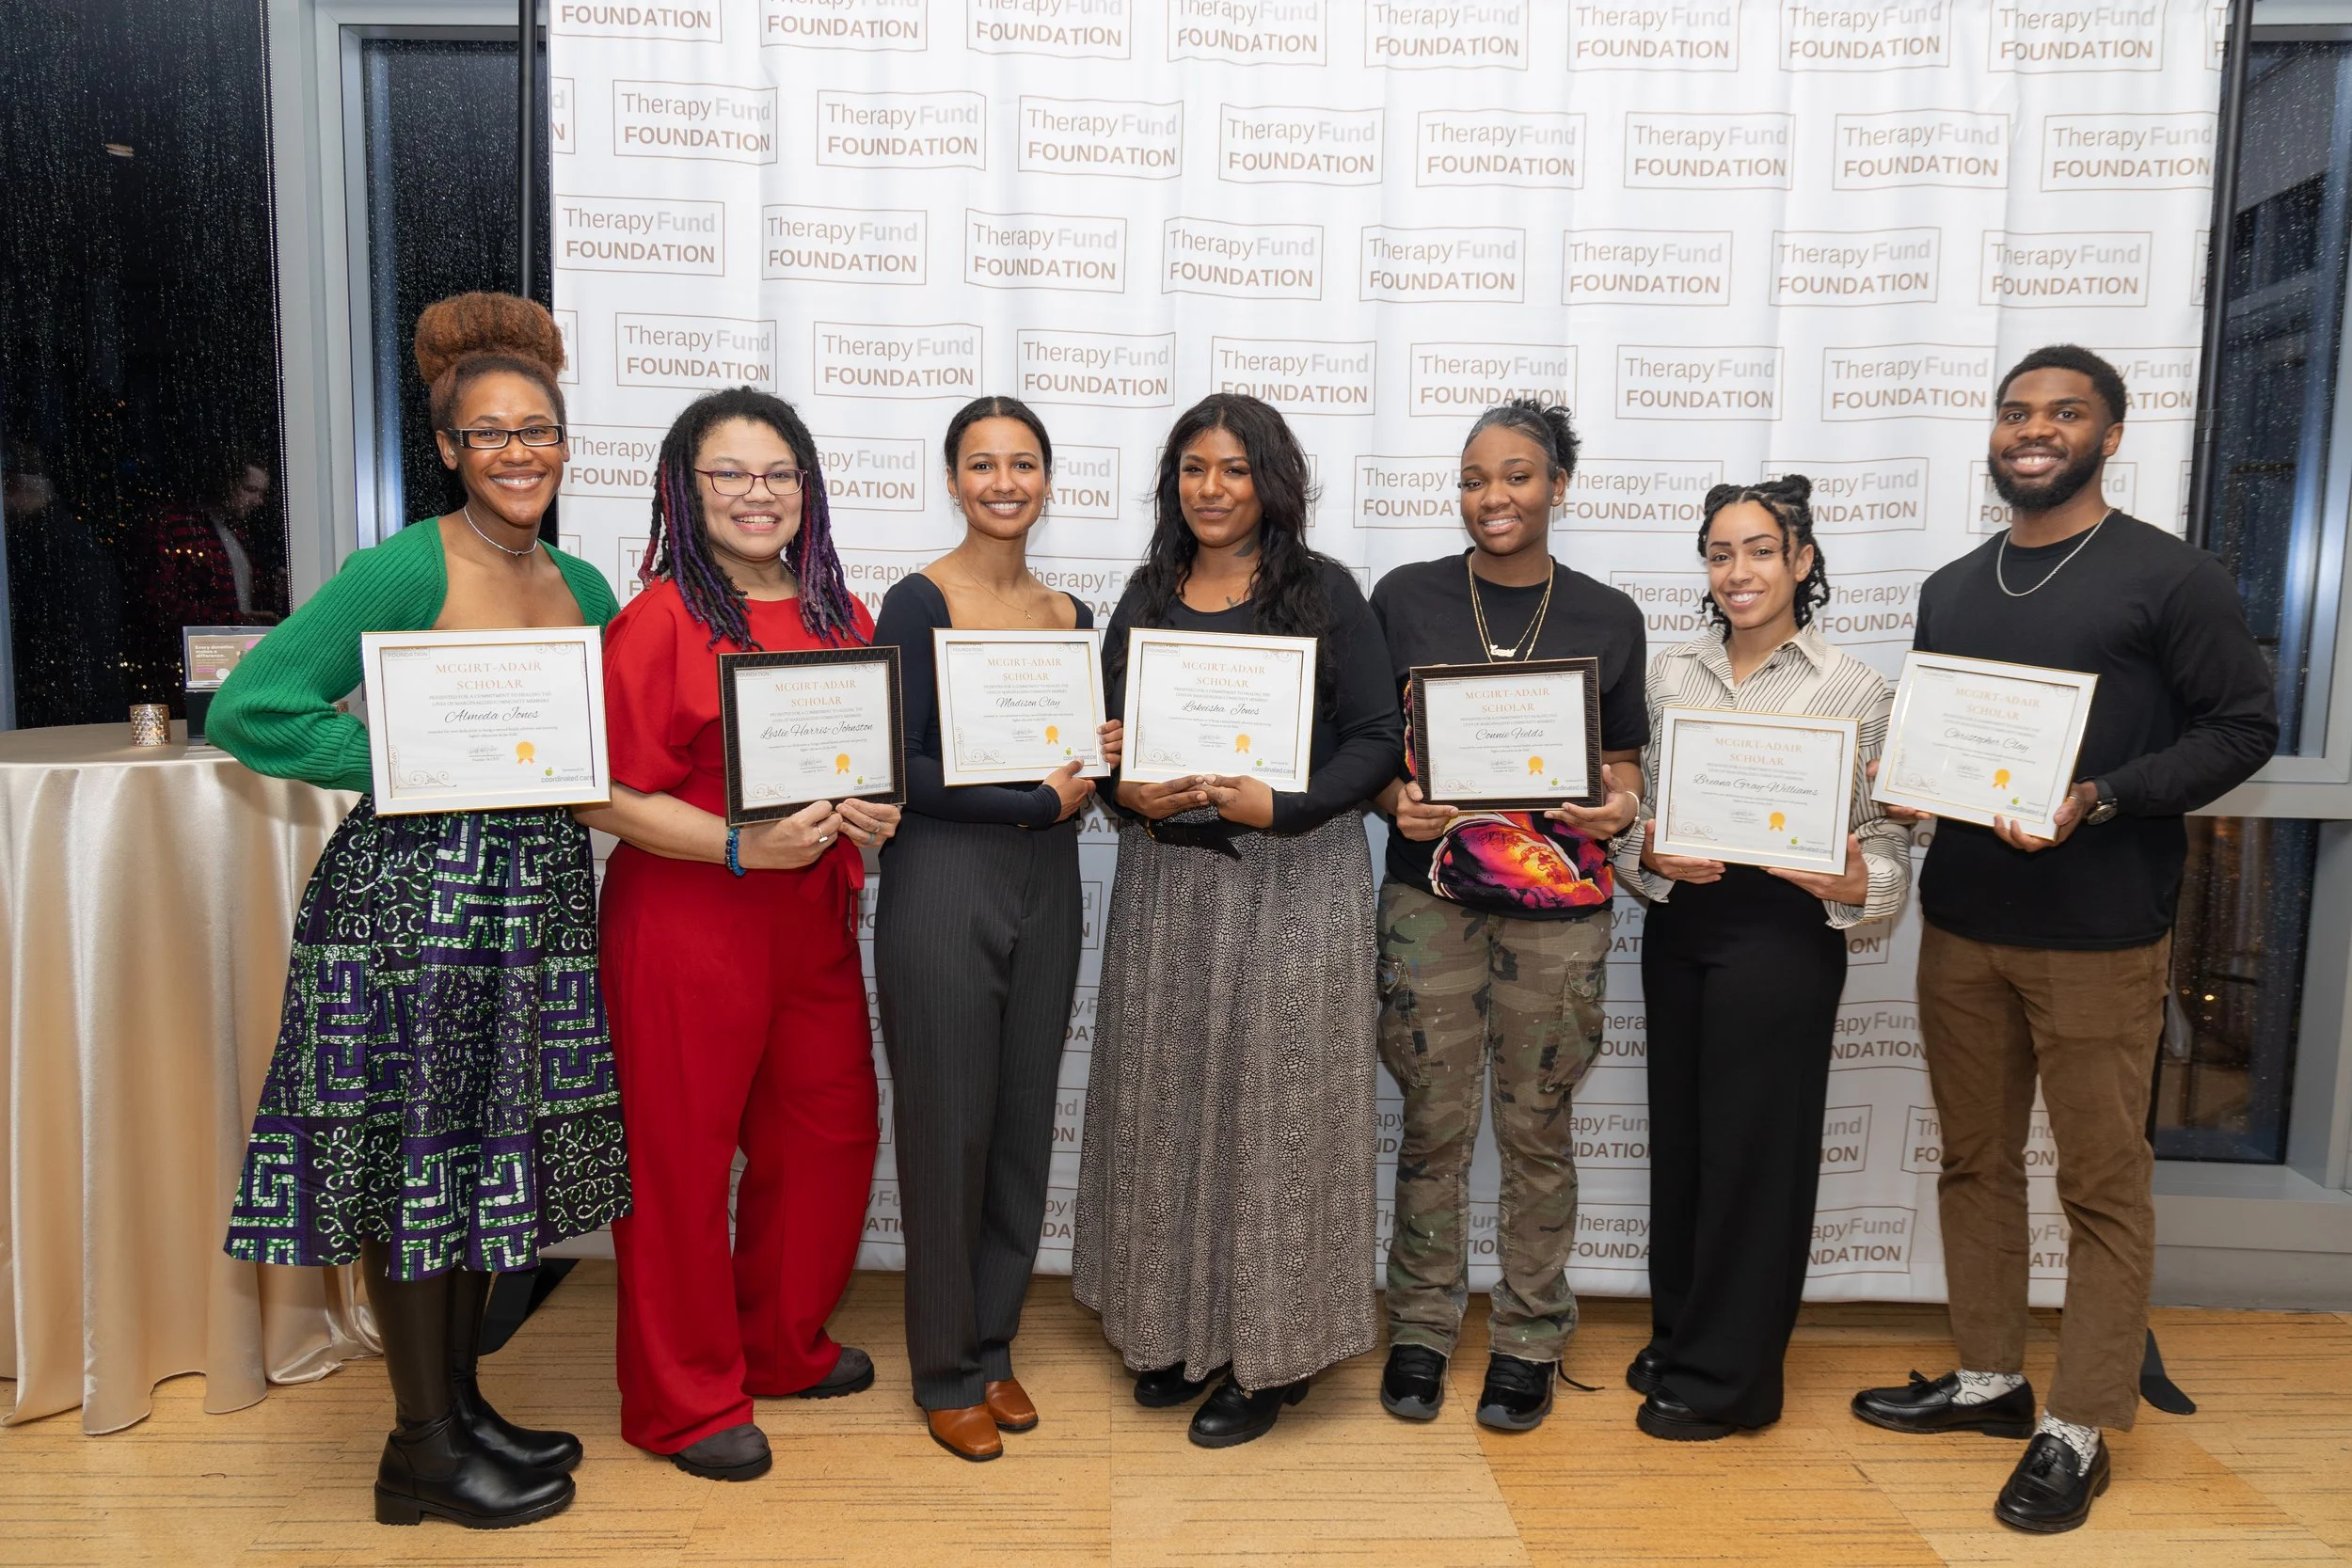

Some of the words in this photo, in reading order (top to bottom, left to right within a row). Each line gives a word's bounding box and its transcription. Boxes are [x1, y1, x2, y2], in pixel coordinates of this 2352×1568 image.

[563, 5, 712, 29] FOUNDATION
[767, 16, 918, 40] FOUNDATION
[976, 22, 1122, 47] FOUNDATION
[1179, 28, 1318, 54] FOUNDATION
[1377, 37, 1519, 57] FOUNDATION
[1578, 40, 1730, 60] FOUNDATION
[1789, 36, 1941, 60] FOUNDATION
[2002, 40, 2153, 62] FOUNDATION
[626, 127, 771, 152] FOUNDATION
[829, 136, 977, 157] FOUNDATION
[1029, 142, 1176, 167] FOUNDATION
[1230, 152, 1375, 174] FOUNDATION
[1429, 155, 1576, 178] FOUNDATION
[1635, 159, 1788, 179] FOUNDATION
[1845, 155, 2000, 179] FOUNDATION
[2054, 158, 2212, 180] FOUNDATION
[567, 241, 715, 264] FOUNDATION
[770, 250, 917, 274] FOUNDATION
[974, 257, 1117, 281] FOUNDATION
[1170, 261, 1313, 288] FOUNDATION
[1371, 271, 1516, 292] FOUNDATION
[1571, 275, 1721, 294] FOUNDATION
[1778, 273, 1930, 296] FOUNDATION
[1993, 275, 2139, 296] FOUNDATION
[628, 357, 771, 383] FOUNDATION
[826, 367, 974, 388] FOUNDATION
[1025, 374, 1168, 397] FOUNDATION
[1628, 390, 1774, 410] FOUNDATION
[1833, 388, 1987, 410] FOUNDATION
[823, 479, 914, 499] DATION
[1810, 501, 1916, 522] NDATION
[1821, 612, 1916, 633] FOUNDA
[437, 661, 542, 673] MCGIRT-ADAIR
[988, 657, 1061, 667] MCGIRT-ADAIR
[1182, 661, 1265, 674] MCGIRT-ADAIR
[457, 679, 523, 690] SCHOLAR
[775, 679, 856, 692] MCGIRT-ADAIR
[1003, 673, 1050, 681] SCHOLAR
[1197, 676, 1248, 688] SCHOLAR
[791, 696, 842, 706] SCHOLAR
[995, 697, 1036, 707] Madison
[1039, 698, 1060, 708] Clay
[1465, 688, 1550, 700] MCGIRT-ADAIR
[1955, 687, 2041, 707] MCGIRT-ADAIR
[445, 709, 499, 723] Almeda
[502, 706, 539, 721] Jones
[1231, 704, 1260, 715] Jones
[1482, 703, 1534, 713] SCHOLAR
[1965, 705, 2020, 721] SCHOLAR
[760, 724, 788, 738] Leslie
[790, 721, 873, 736] Harris-Johnston
[1475, 729, 1509, 740] Connie
[1511, 727, 1544, 739] Fields
[1715, 737, 1803, 752] MCGIRT-ADAIR
[1730, 752, 1784, 766] SCHOLAR
[1693, 773, 1731, 787] Breana
[1831, 1040, 1928, 1060] NDATION
[1809, 1245, 1901, 1265] NDATION
